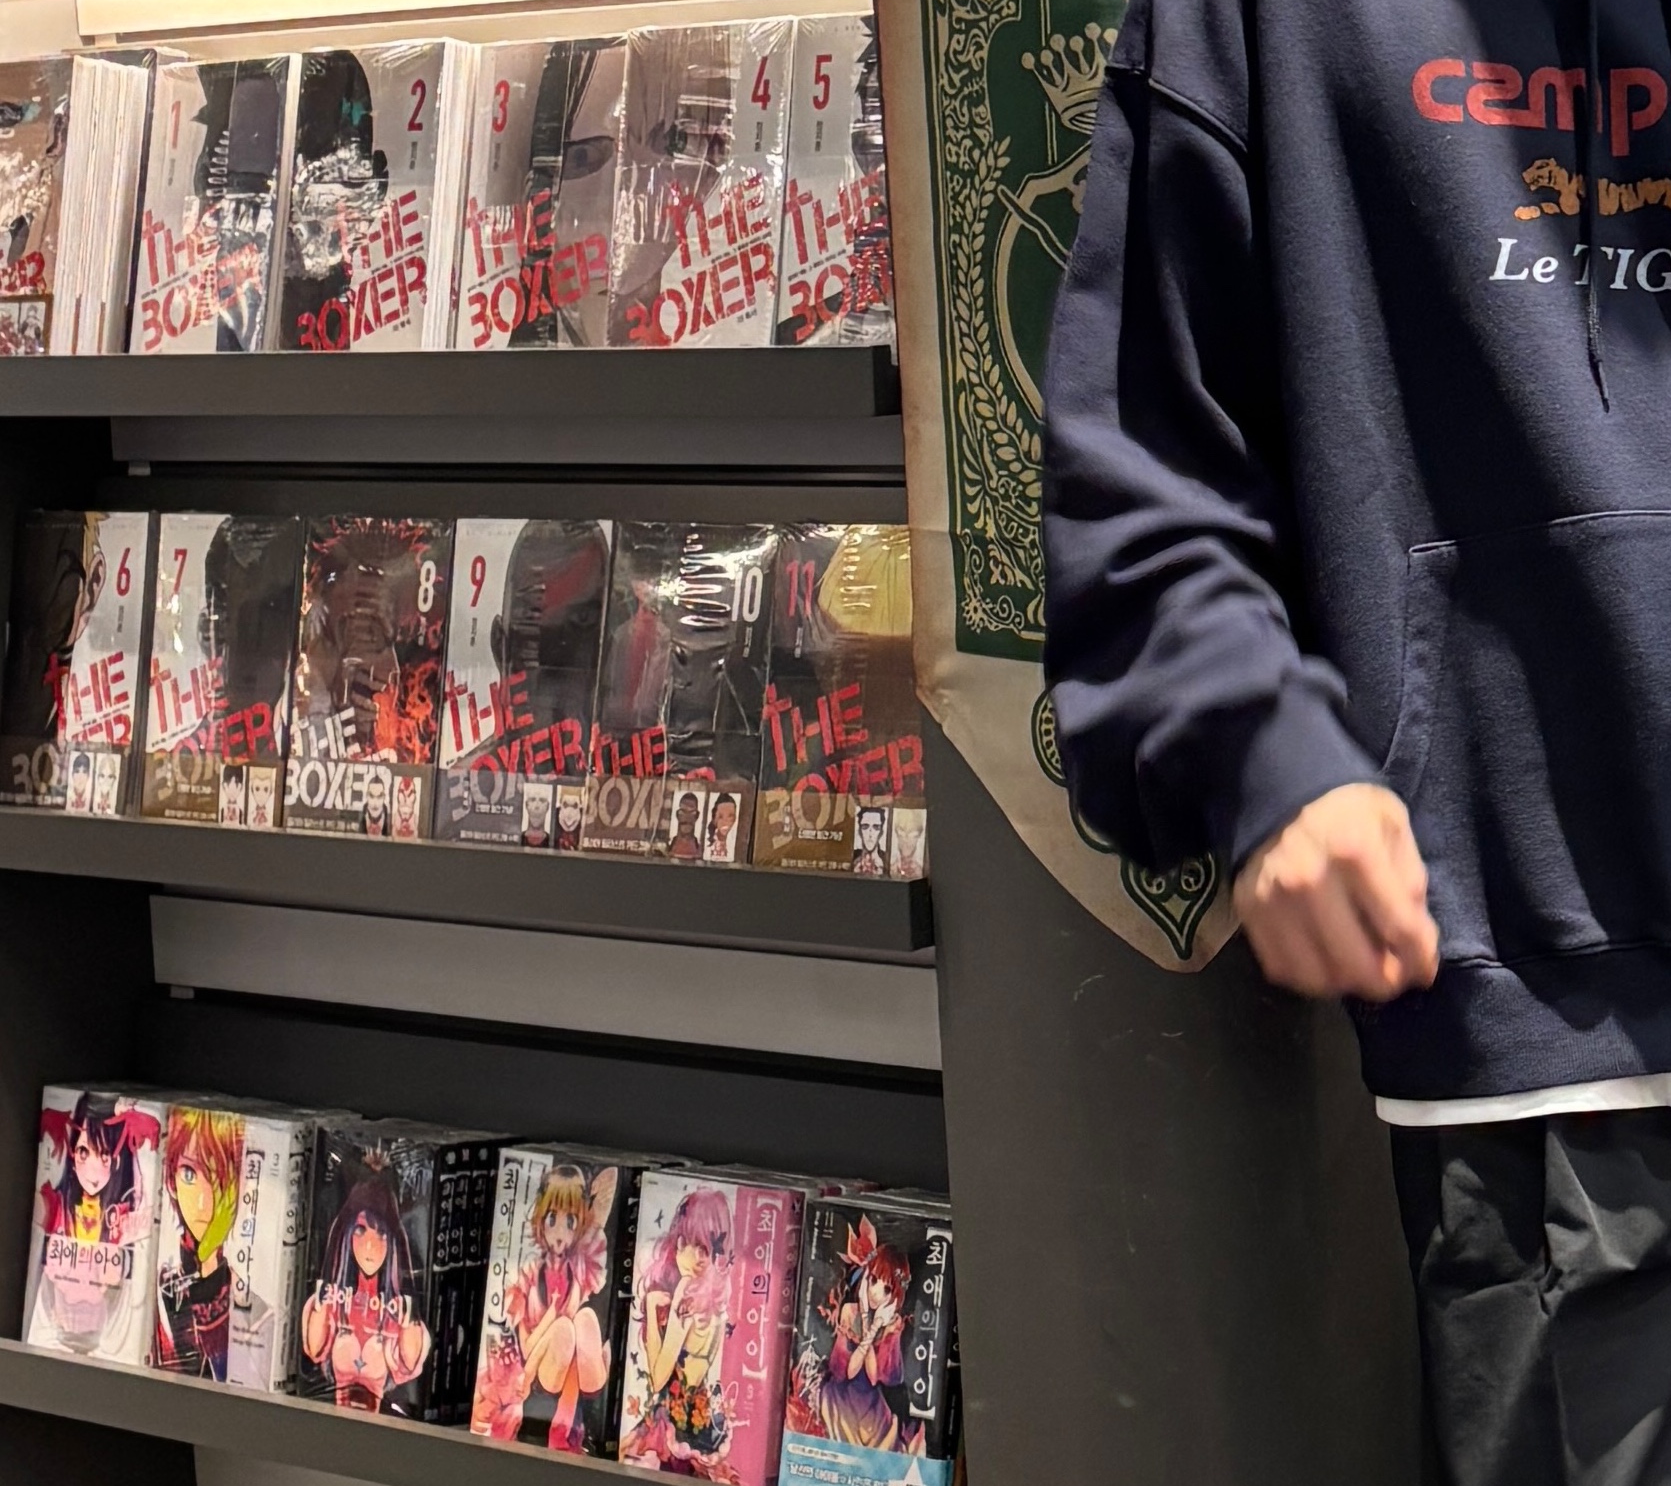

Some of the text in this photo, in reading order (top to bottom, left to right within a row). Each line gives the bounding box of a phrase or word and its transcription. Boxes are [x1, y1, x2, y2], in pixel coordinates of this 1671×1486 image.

[407, 78, 426, 132] 2
[491, 79, 510, 133] 3
[751, 56, 771, 111] 4
[812, 54, 833, 111] 5
[171, 101, 182, 150] 1
[142, 207, 220, 287] THE
[465, 188, 557, 278] THE
[664, 171, 772, 269] THE
[1489, 237, 1560, 284] Le
[116, 547, 131, 597] 6
[173, 548, 188, 594] 7
[417, 560, 436, 612] 8
[470, 555, 486, 607] 9
[731, 566, 763, 623] 10
[786, 560, 816, 617] 11
[150, 656, 230, 735] THE
[445, 670, 534, 754] THE
[763, 681, 869, 773] THE
